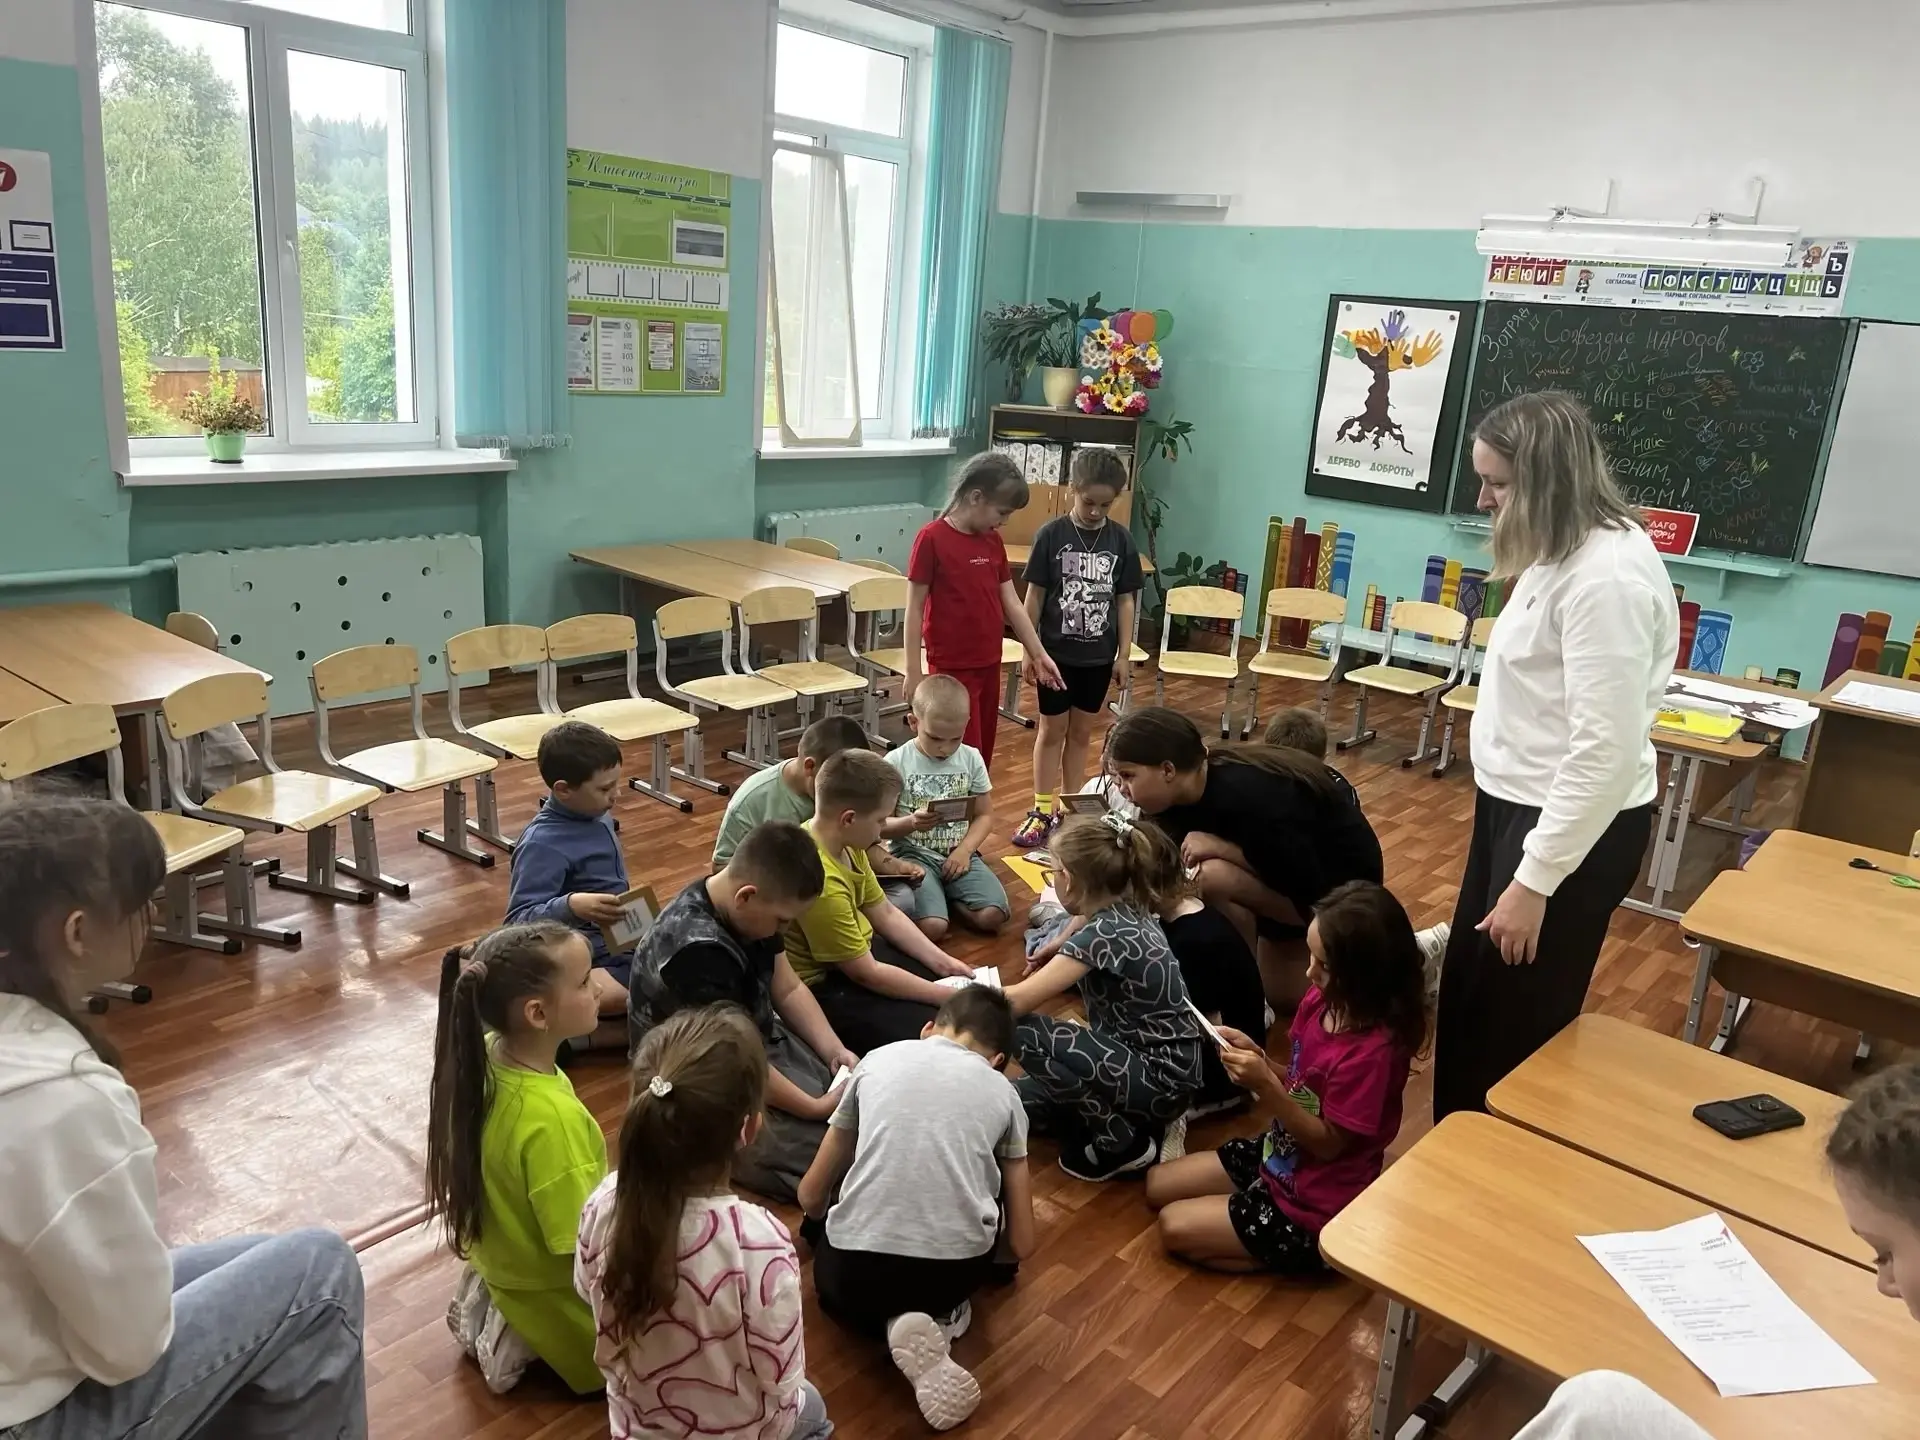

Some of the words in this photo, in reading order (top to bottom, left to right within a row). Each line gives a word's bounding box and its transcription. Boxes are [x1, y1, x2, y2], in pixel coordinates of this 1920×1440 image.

[586, 152, 651, 181] Классная
[1544, 309, 1637, 369] Созвездие
[1327, 455, 1361, 469] ДЕРЕВО
[1369, 462, 1415, 477] ДОБРОТЫ
[1648, 520, 1678, 531] ЛАГО
